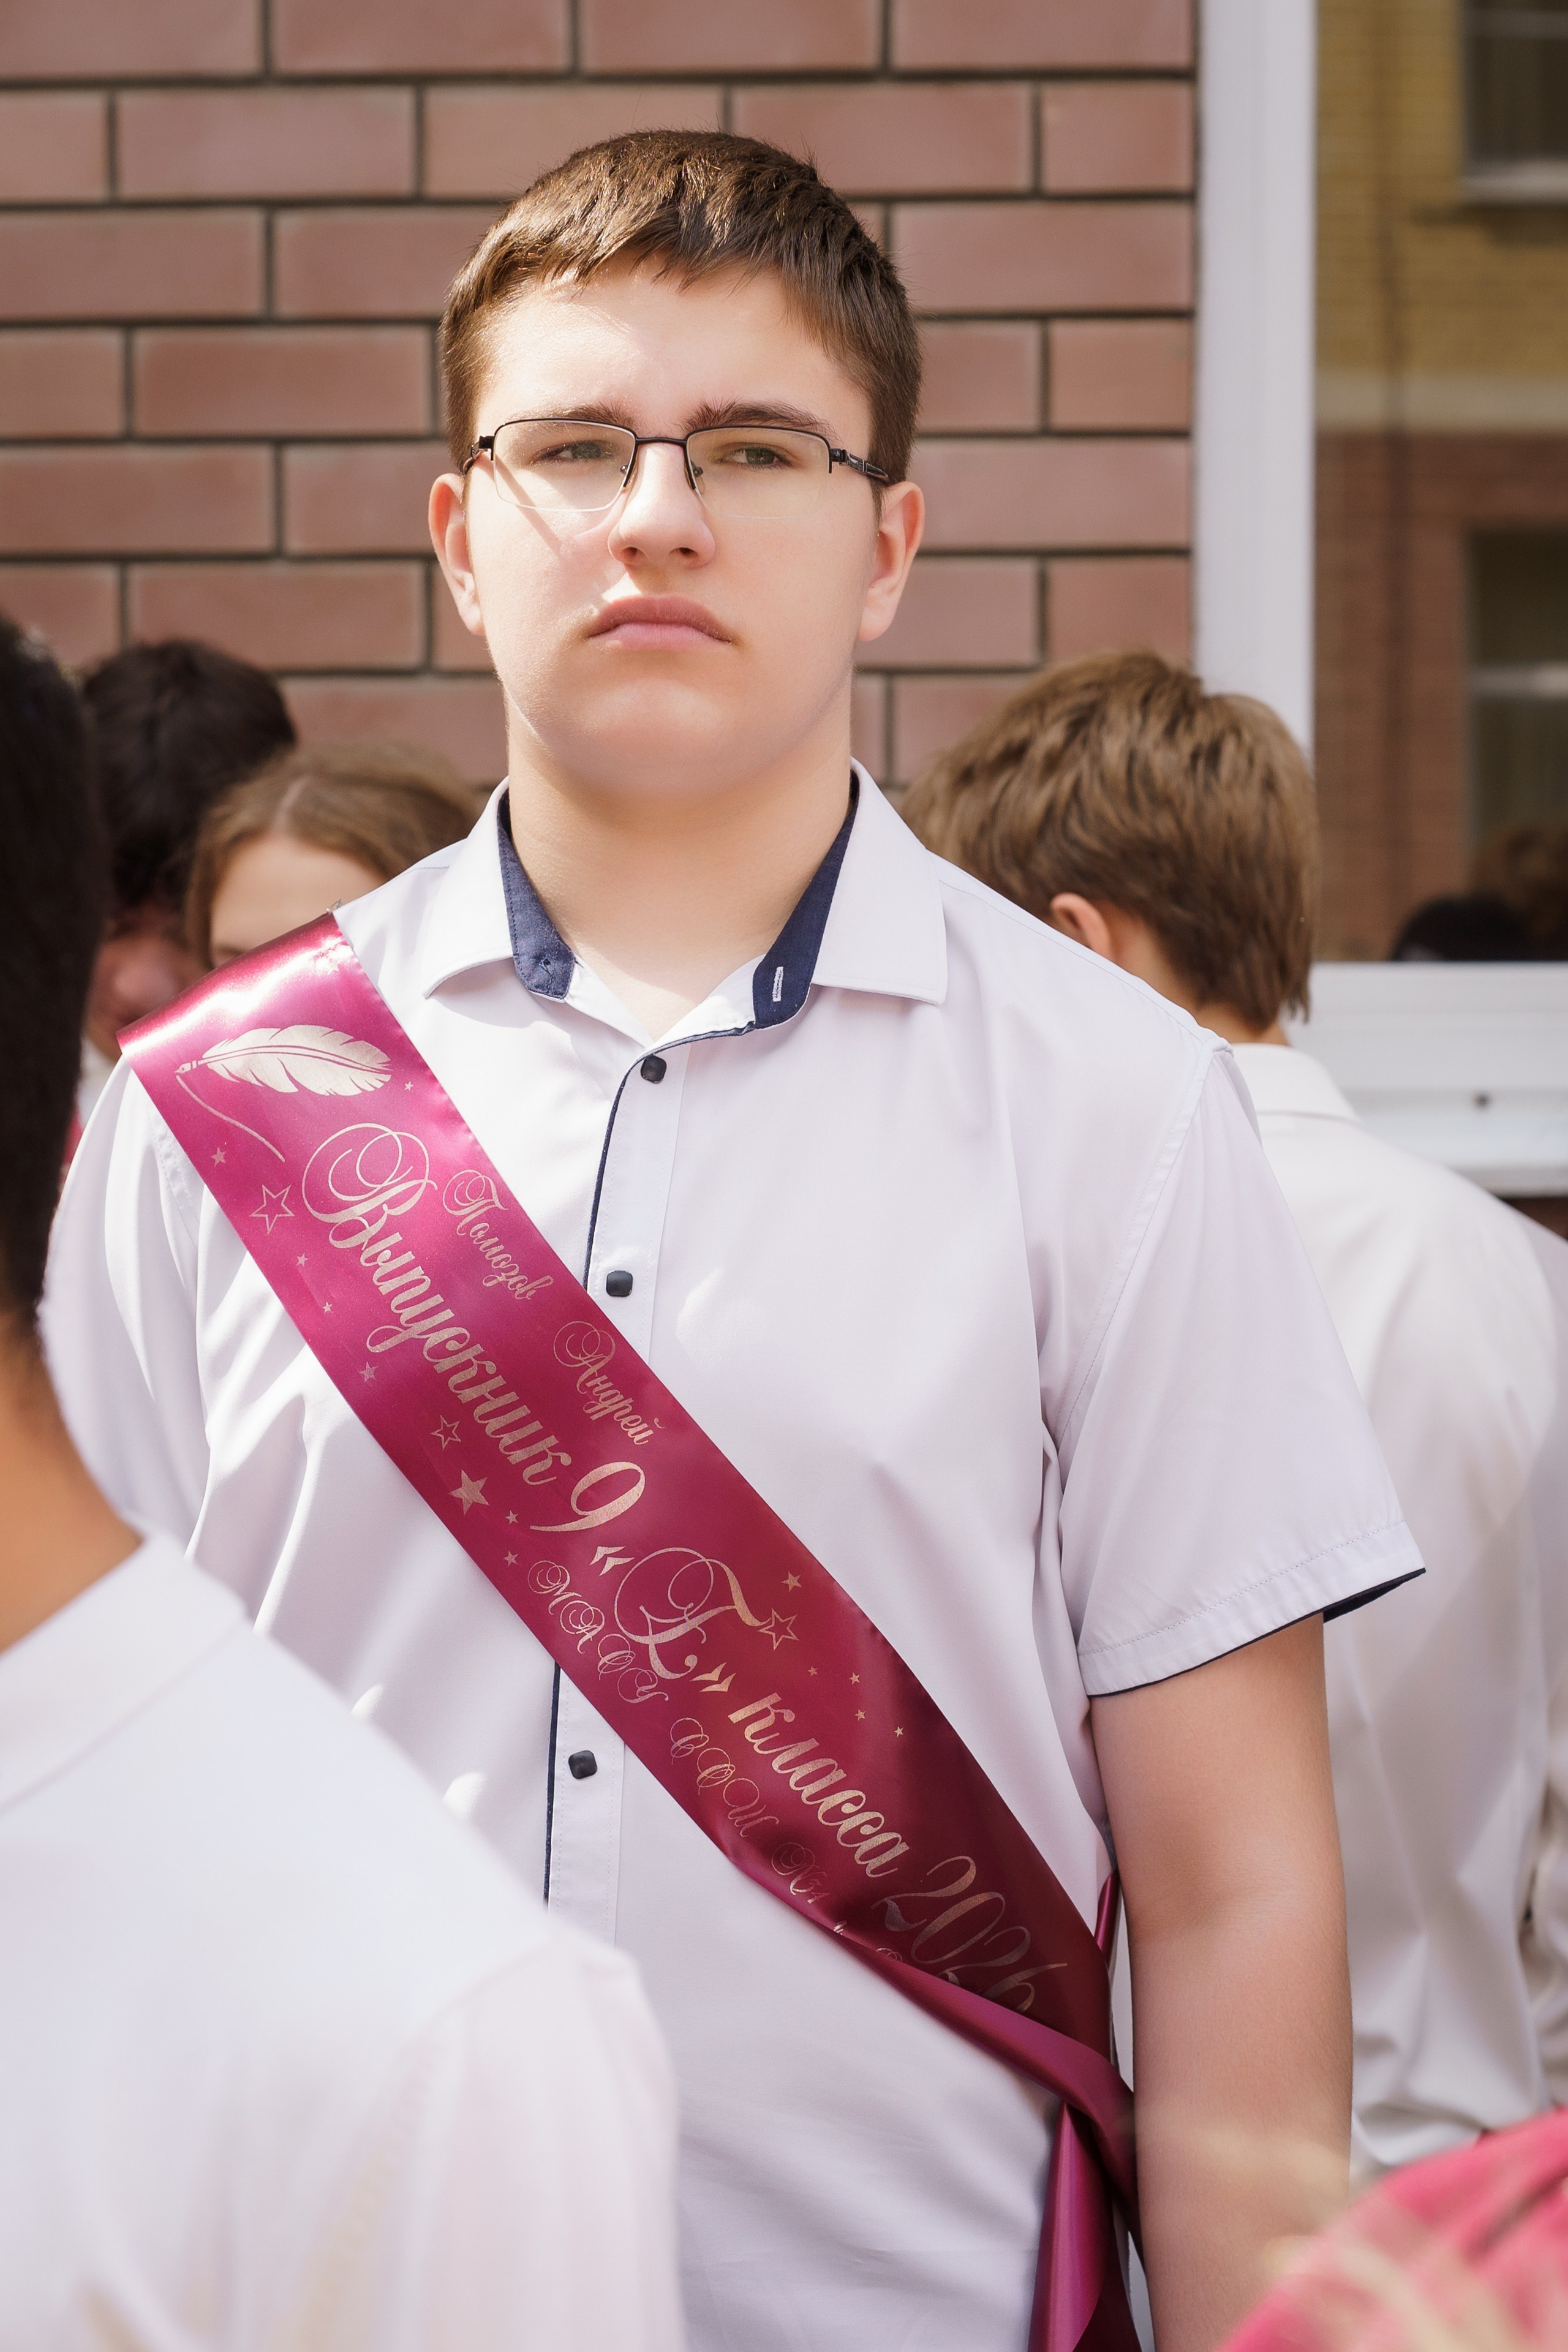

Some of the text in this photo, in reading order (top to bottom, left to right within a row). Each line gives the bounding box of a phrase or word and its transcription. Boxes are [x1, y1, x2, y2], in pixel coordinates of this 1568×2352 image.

[301, 1123, 571, 1485] Выпускник
[529, 1461, 645, 1532] 9
[728, 1692, 910, 1877] класса
[443, 1169, 664, 1445] Помозов Андрей
